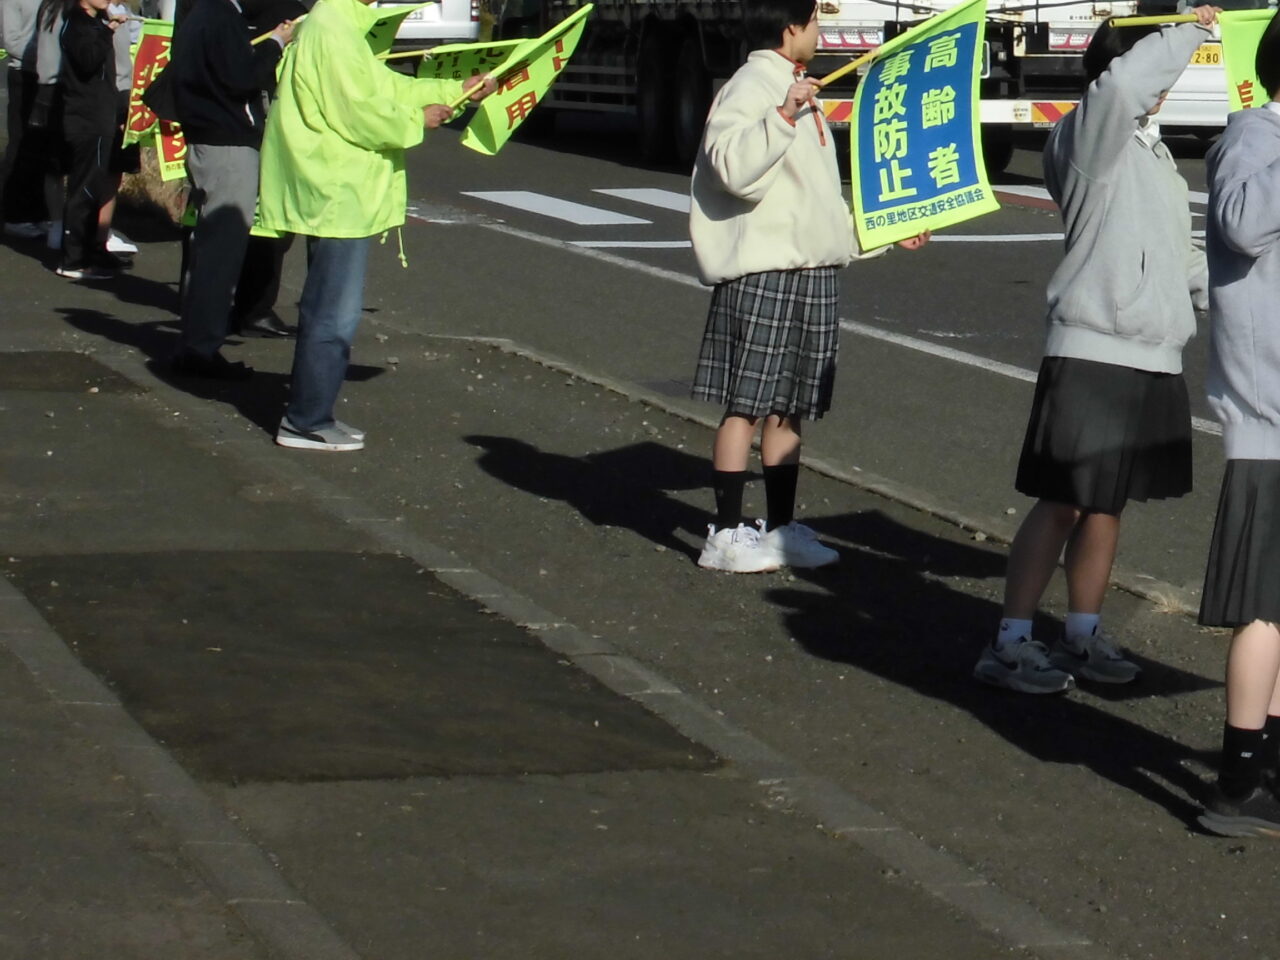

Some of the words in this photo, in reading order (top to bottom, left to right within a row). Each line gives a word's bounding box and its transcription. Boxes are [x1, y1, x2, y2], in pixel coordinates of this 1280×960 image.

[873, 49, 918, 203] 事故防止
[921, 32, 962, 189] 高齢者
[864, 188, 985, 230] 西の里地区交通安全協議会
